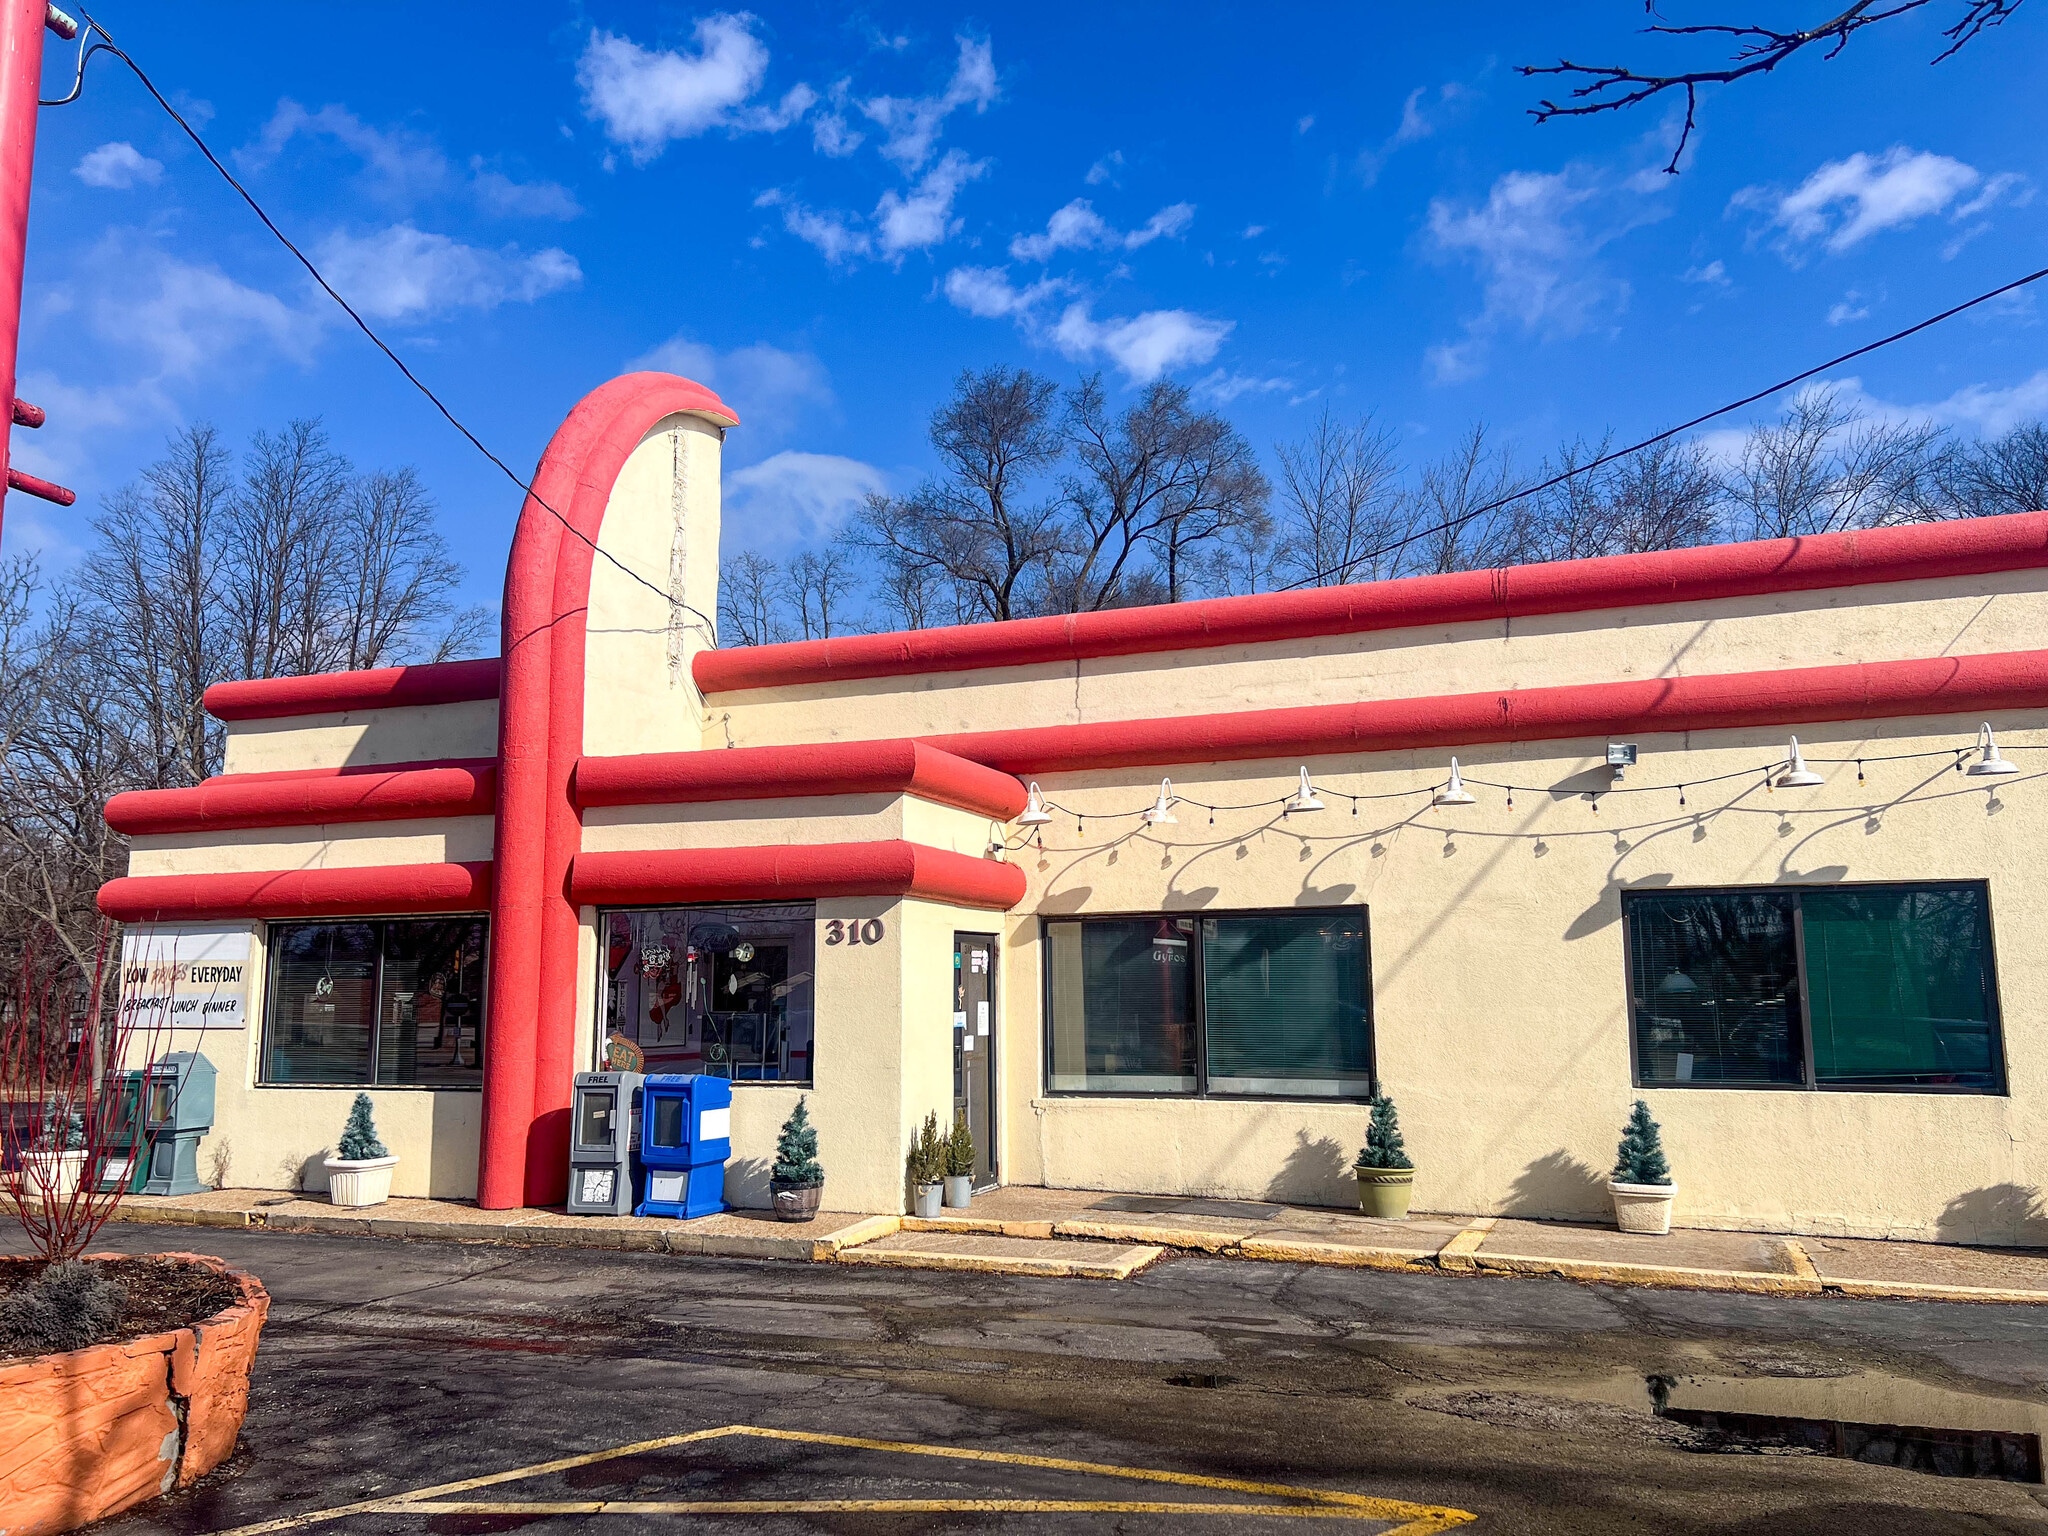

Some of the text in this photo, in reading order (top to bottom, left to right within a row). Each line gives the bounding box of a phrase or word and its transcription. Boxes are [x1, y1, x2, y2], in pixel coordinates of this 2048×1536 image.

[825, 918, 885, 946] 310
[1153, 950, 1186, 963] Gyros
[126, 963, 243, 985] LOW PRICES EVERYDAY
[124, 996, 237, 1014] BREAKFAST LUNCH DINNER
[613, 1046, 635, 1063] EAT
[611, 1056, 631, 1070] HERE
[587, 1075, 609, 1084] FREE
[660, 1075, 682, 1083] FREE
